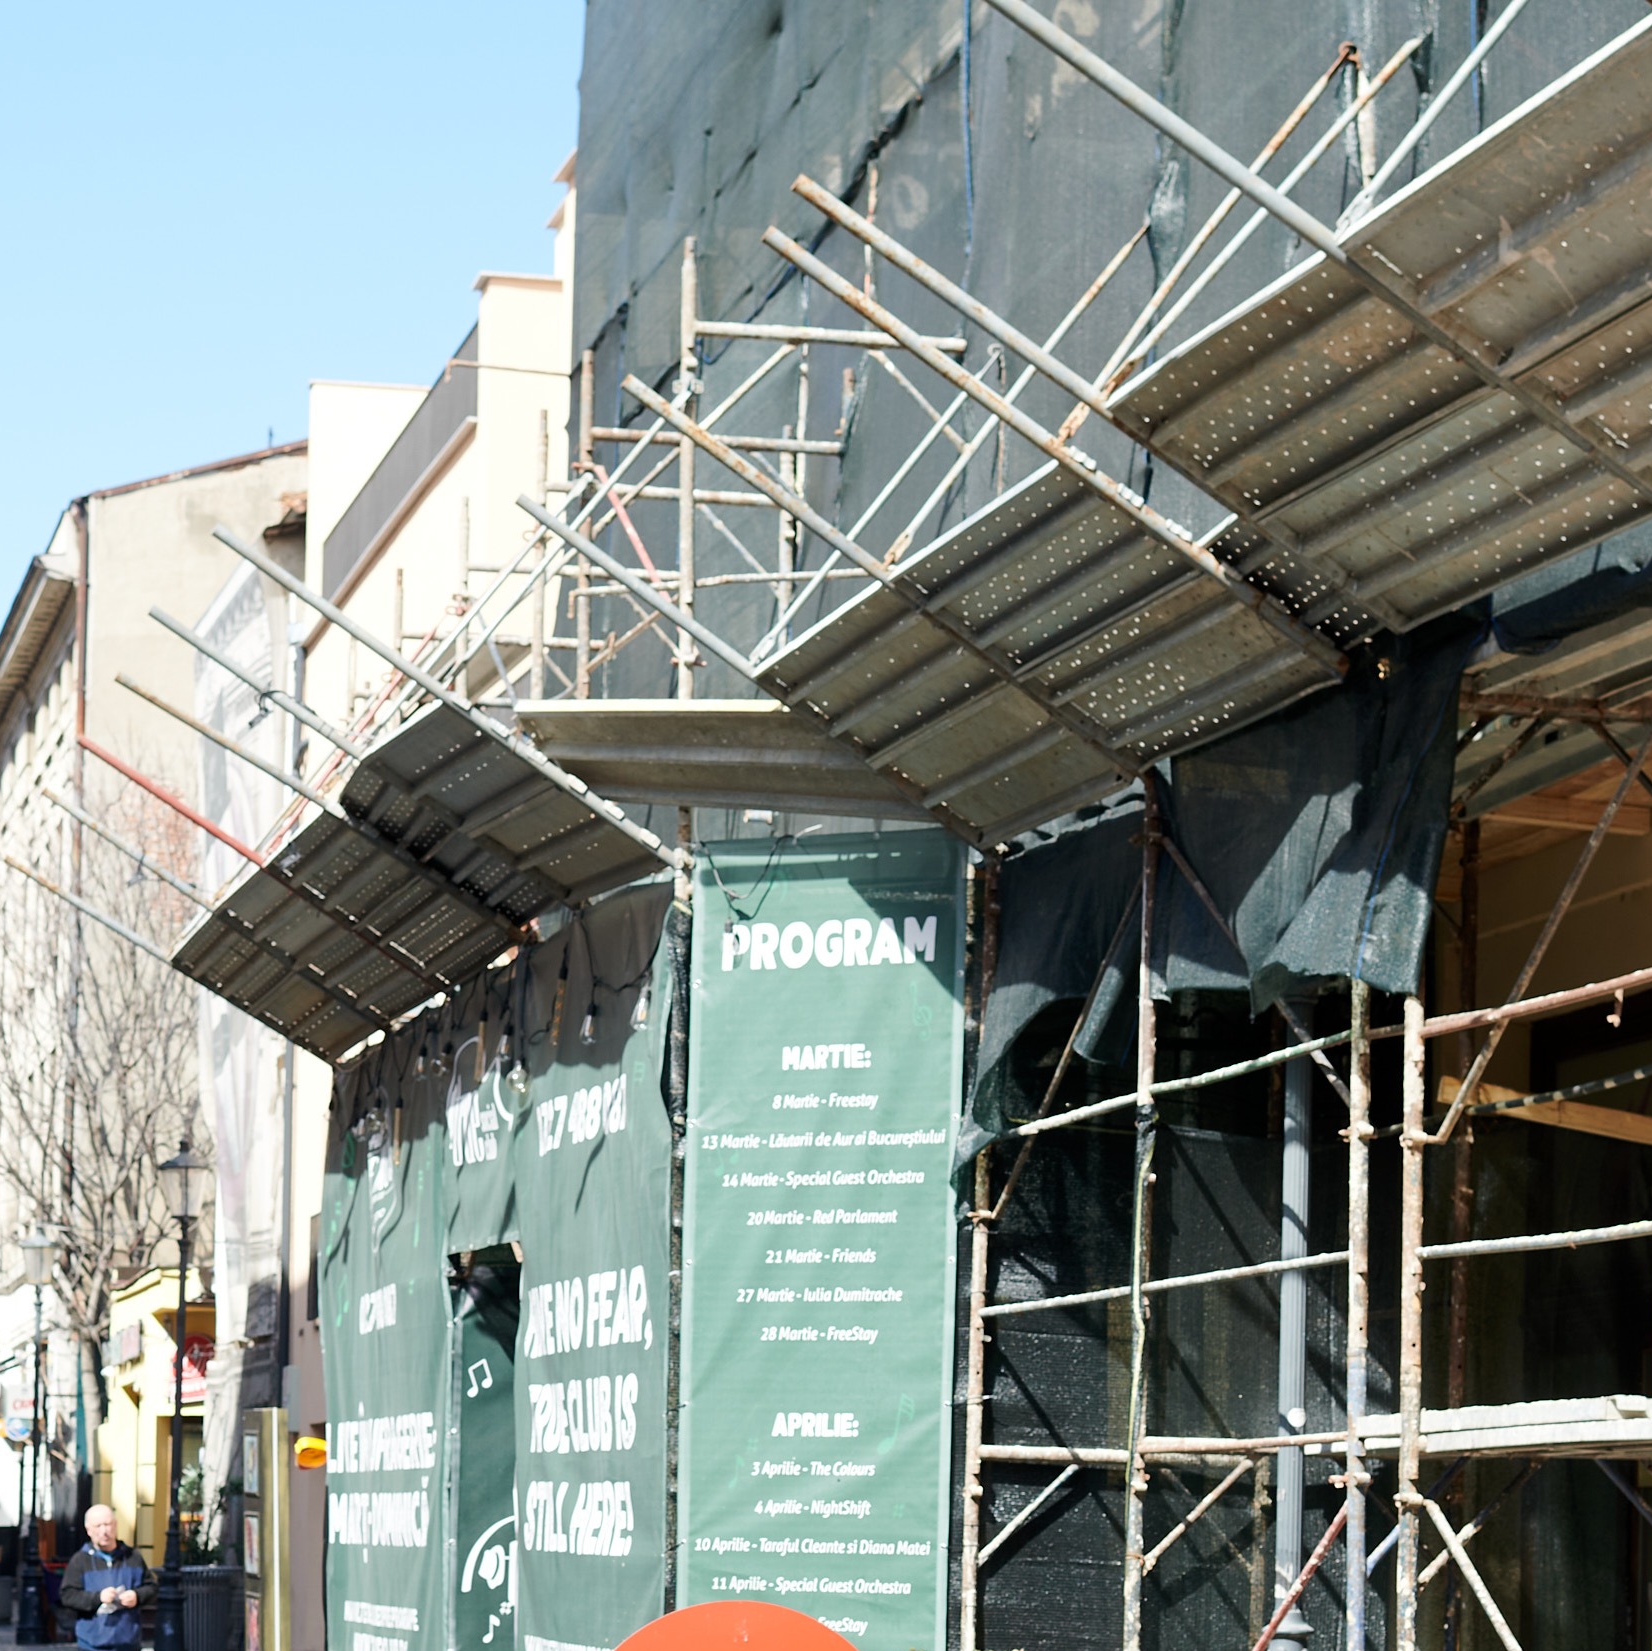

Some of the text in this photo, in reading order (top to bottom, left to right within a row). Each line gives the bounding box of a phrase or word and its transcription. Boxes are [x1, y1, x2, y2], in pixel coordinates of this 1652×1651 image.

[721, 916, 937, 971] PROGRAM
[782, 1043, 872, 1071] MARTIE:
[772, 1095, 782, 1109] 8
[783, 1093, 819, 1109] Martie
[829, 1092, 879, 1110] Freestay
[702, 1135, 718, 1149] 13
[720, 1133, 760, 1148] Martie
[815, 1132, 831, 1146] de
[833, 1132, 853, 1146] Aur
[723, 1174, 738, 1188] 14
[740, 1172, 778, 1187] Martie
[785, 1171, 831, 1189] Special
[832, 1171, 865, 1185] Guest
[867, 1169, 925, 1185] Orchestra
[747, 1212, 764, 1226] 20
[764, 1210, 804, 1225] Martie
[813, 1209, 835, 1224] Red
[836, 1209, 898, 1224] Parlament
[765, 1250, 782, 1264] 21
[785, 1249, 822, 1264] Martie
[832, 1248, 877, 1264] Friends
[736, 1288, 754, 1303] 27
[757, 1287, 795, 1302] Martie
[803, 1287, 832, 1302] Iulia
[834, 1287, 903, 1302] Dumitrache
[555, 1277, 584, 1353] NO
[587, 1265, 653, 1351] FEAR,
[761, 1327, 777, 1341] 28
[778, 1326, 818, 1341] Martie
[827, 1326, 878, 1345] FreeStay
[567, 1376, 612, 1453] CLUB
[615, 1372, 638, 1451] IS
[771, 1412, 859, 1438] APRILIE:
[751, 1462, 760, 1476] 3
[762, 1461, 801, 1479] Aprilie
[810, 1461, 832, 1476] The
[833, 1461, 875, 1477] Colours
[569, 1480, 634, 1556] HERE!
[754, 1501, 763, 1514] 4
[764, 1499, 802, 1517] Aprilie
[811, 1500, 871, 1519] NightShift
[695, 1538, 711, 1552] 10
[711, 1537, 750, 1555] Aprilie
[759, 1538, 799, 1556] Taraful
[801, 1539, 845, 1554] Cleante
[859, 1540, 894, 1555] Diana
[897, 1541, 931, 1556] Matei
[712, 1577, 727, 1590] 11
[729, 1576, 766, 1594] Aprilie
[775, 1576, 817, 1595] Special
[819, 1578, 853, 1593] Guest
[854, 1578, 911, 1594] Orchestra
